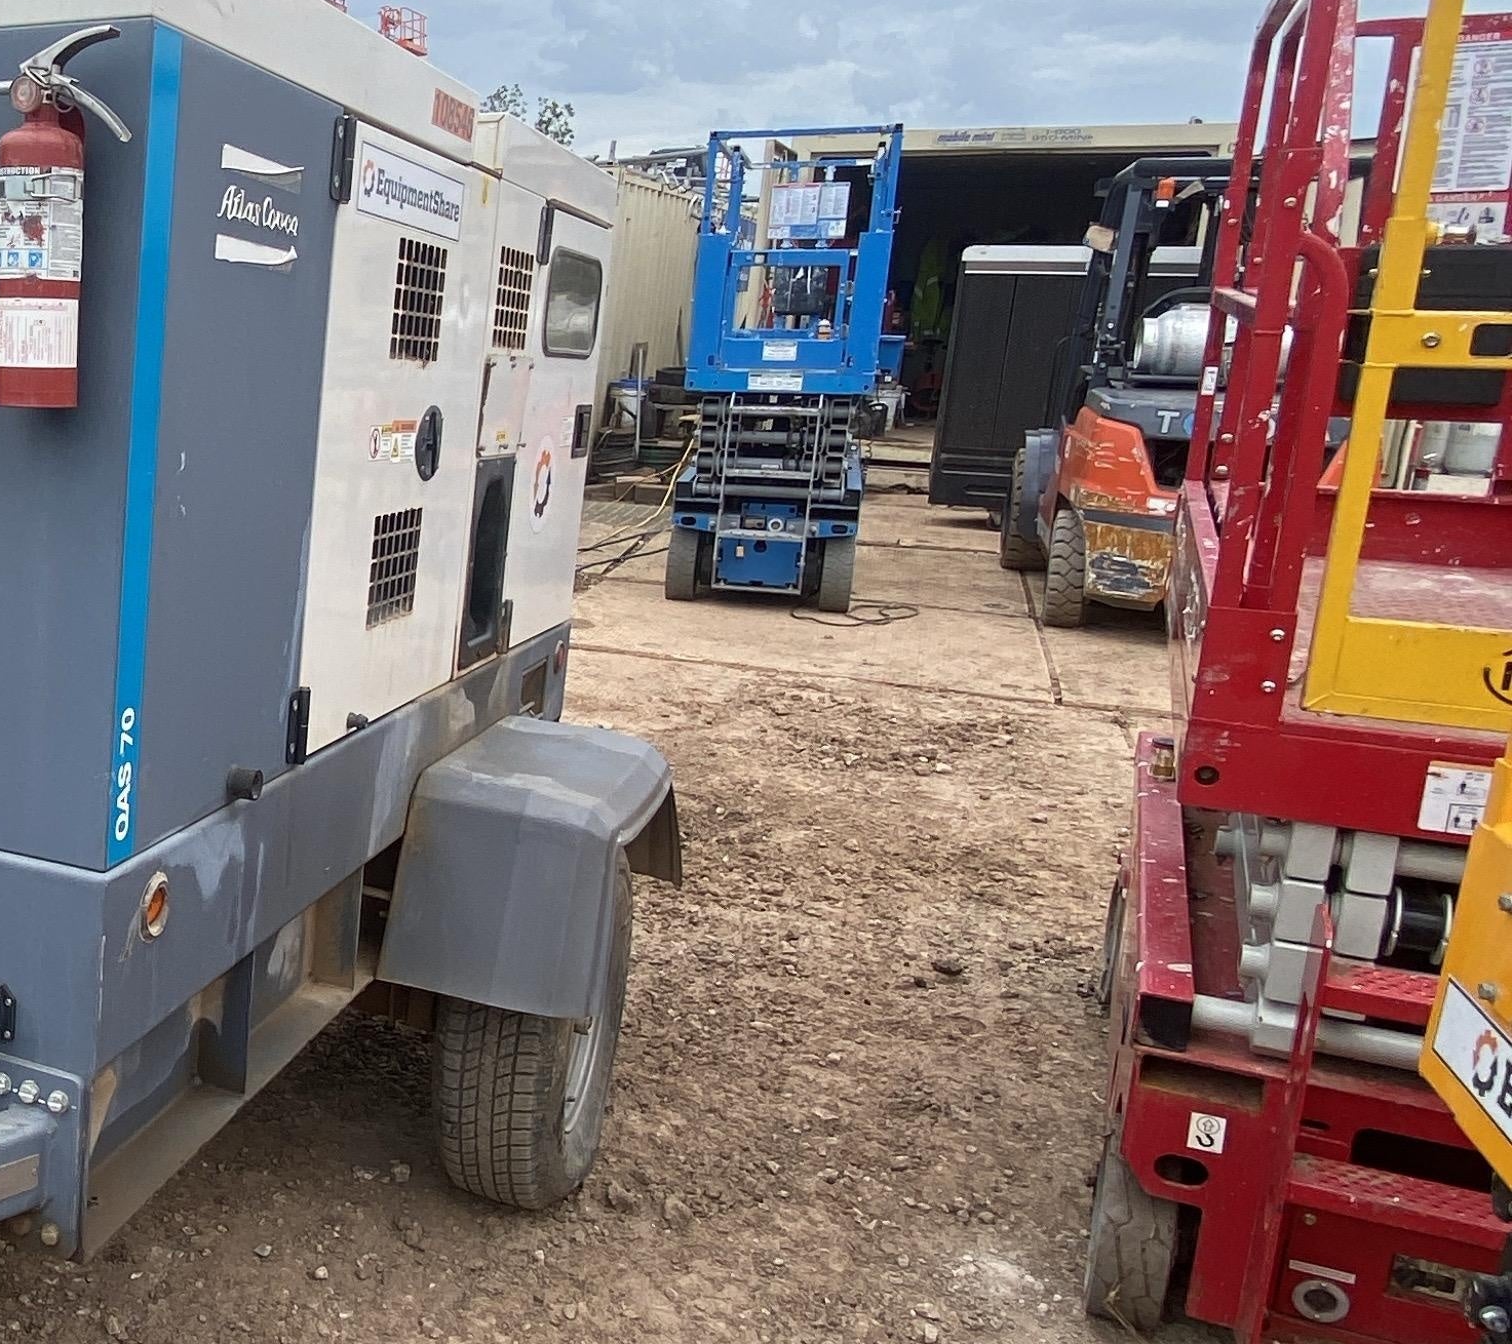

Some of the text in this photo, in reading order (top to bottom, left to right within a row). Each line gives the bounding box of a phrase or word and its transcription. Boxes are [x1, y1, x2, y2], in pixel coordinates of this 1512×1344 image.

[1457, 32, 1501, 42] DANGER
[216, 184, 261, 227] Atlas
[376, 167, 460, 223] EquipmentShare
[119, 706, 136, 757] 70
